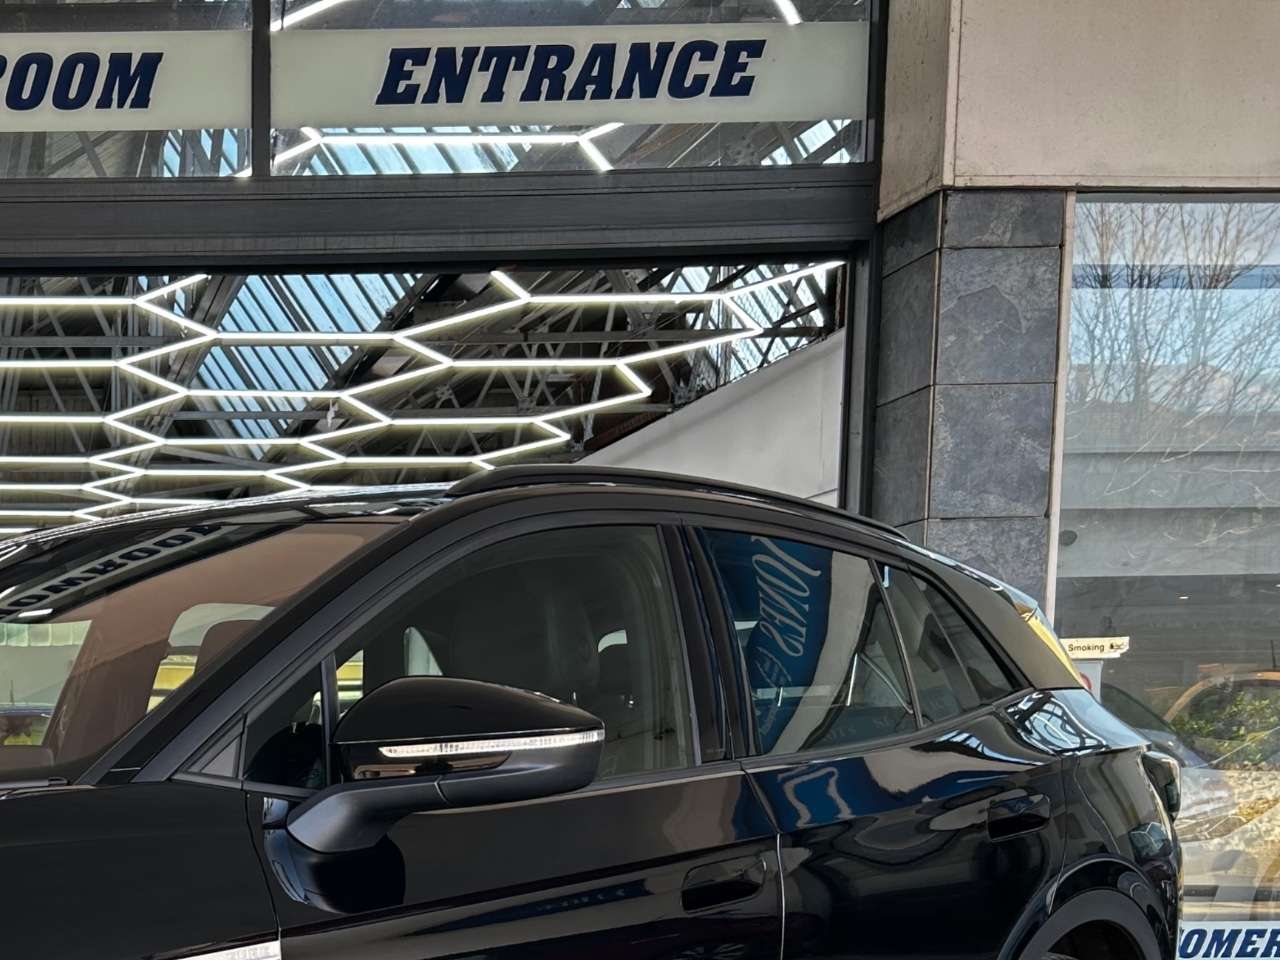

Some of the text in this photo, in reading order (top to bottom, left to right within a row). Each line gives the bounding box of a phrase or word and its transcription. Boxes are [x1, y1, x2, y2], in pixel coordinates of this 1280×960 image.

[375, 39, 767, 105] ENTRANCE
[1067, 643, 1105, 653] Smoking
[1178, 928, 1280, 959] OMER
